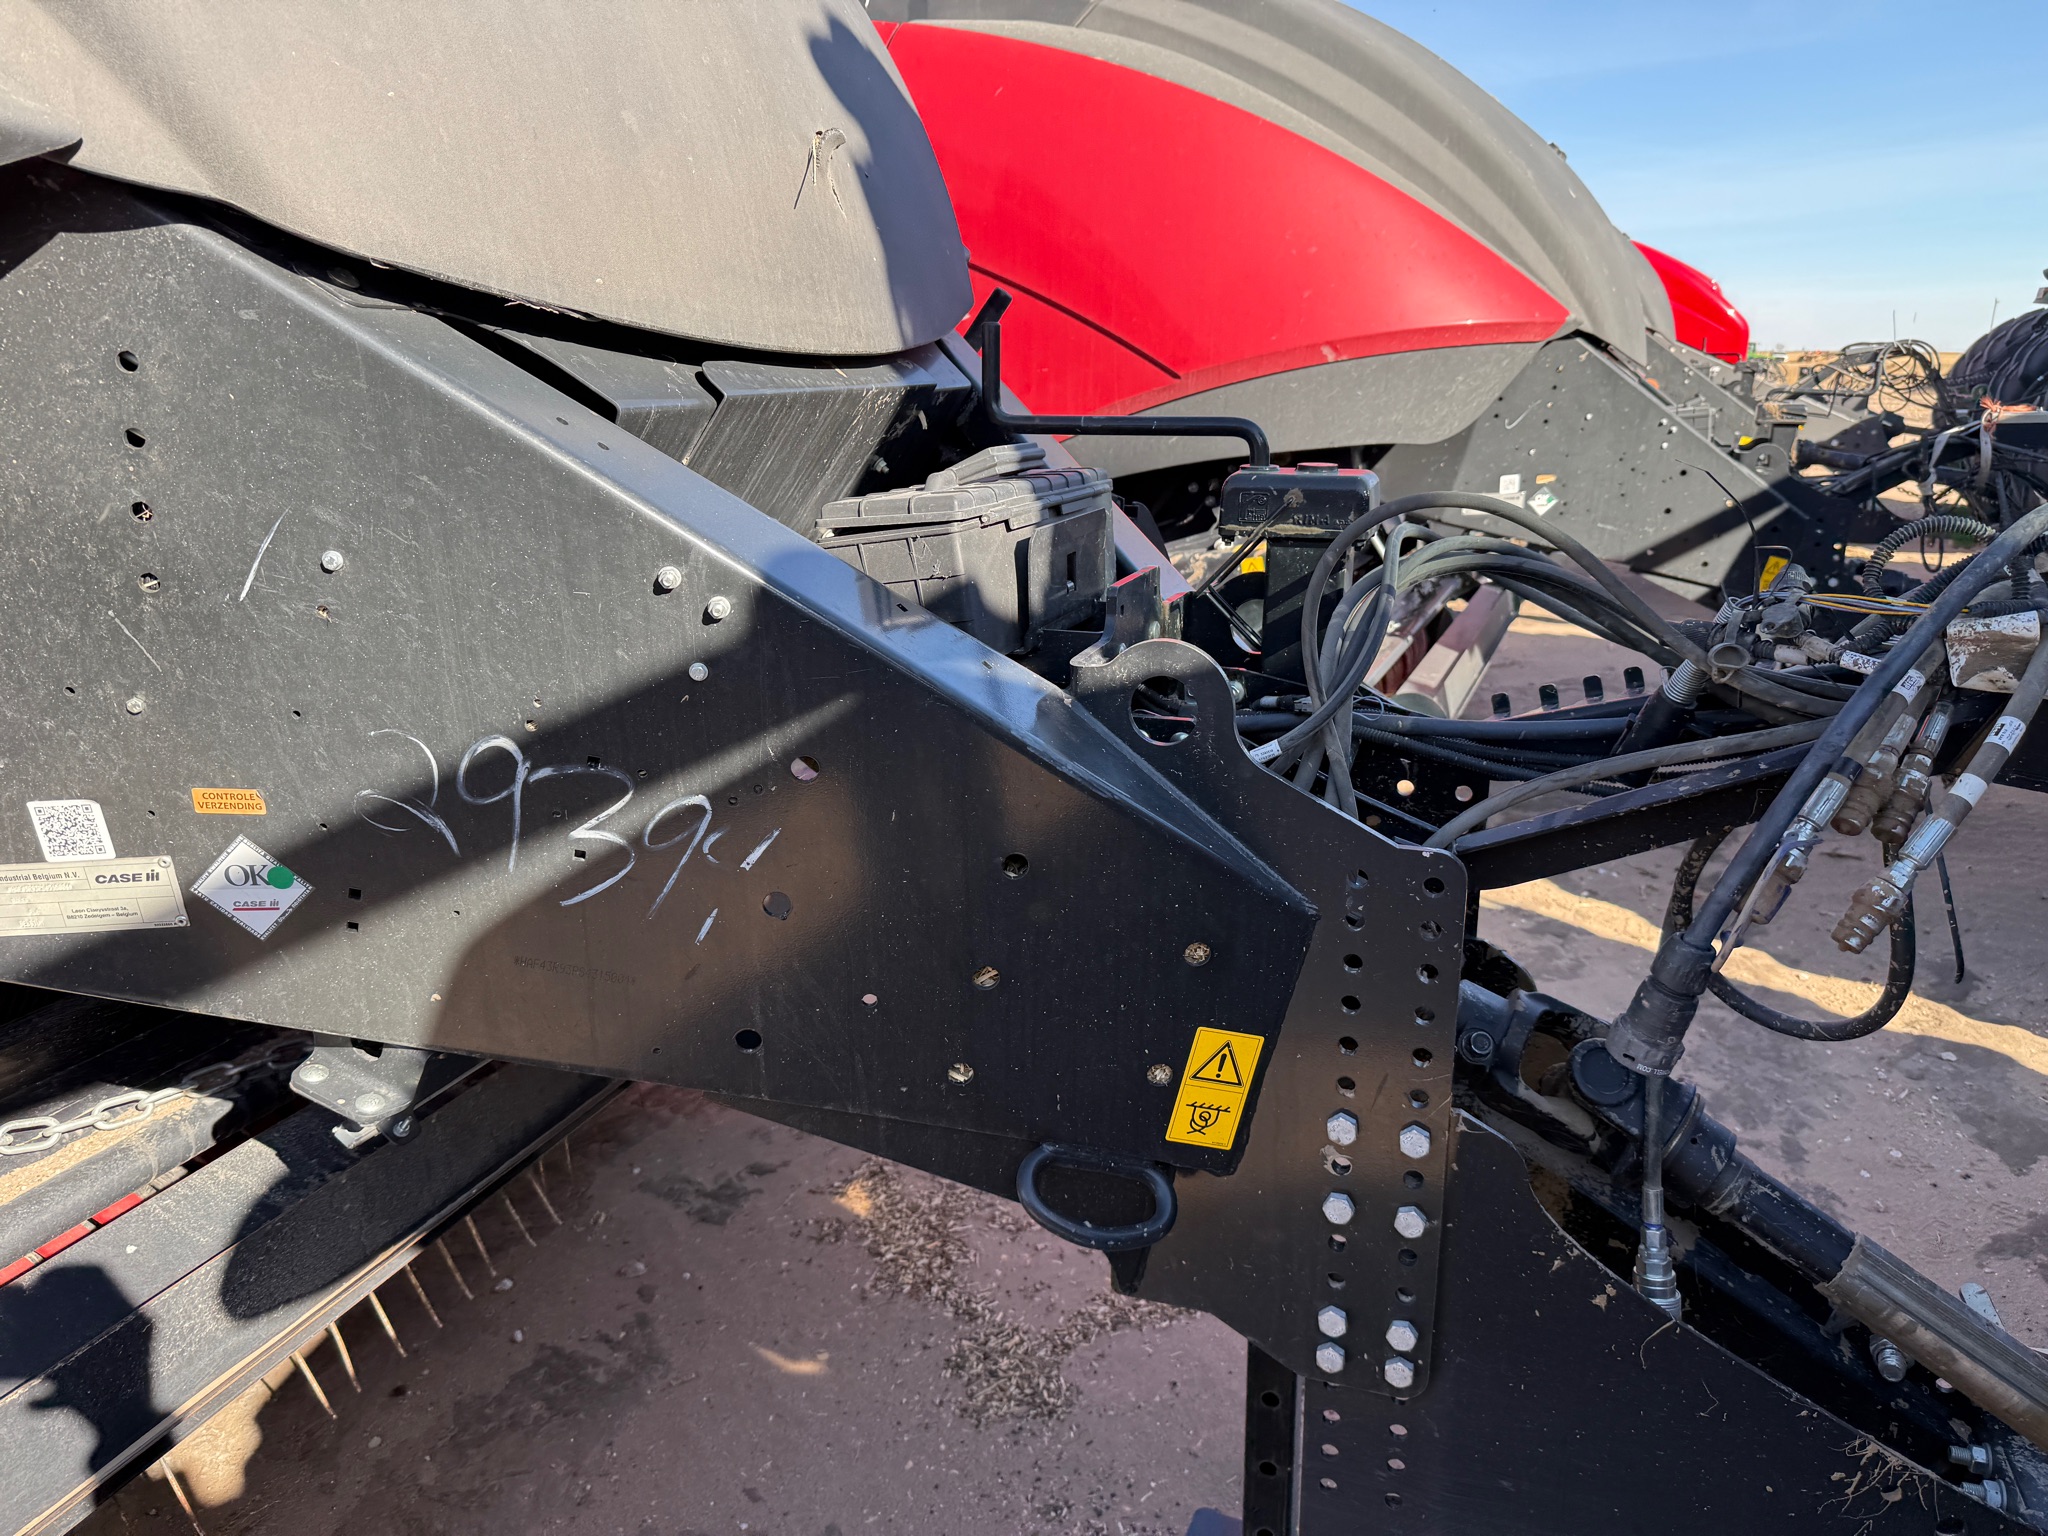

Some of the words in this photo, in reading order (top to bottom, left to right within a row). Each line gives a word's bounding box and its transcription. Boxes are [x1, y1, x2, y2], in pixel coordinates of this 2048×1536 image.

[202, 792, 256, 801] CONTROLE
[197, 802, 263, 811] VERZENDING
[0, 874, 31, 882] ndustrial
[33, 872, 62, 881] Belgium
[95, 872, 142, 884] CASE
[146, 869, 160, 882] IH
[224, 864, 271, 887] OK
[233, 900, 263, 908] CASE
